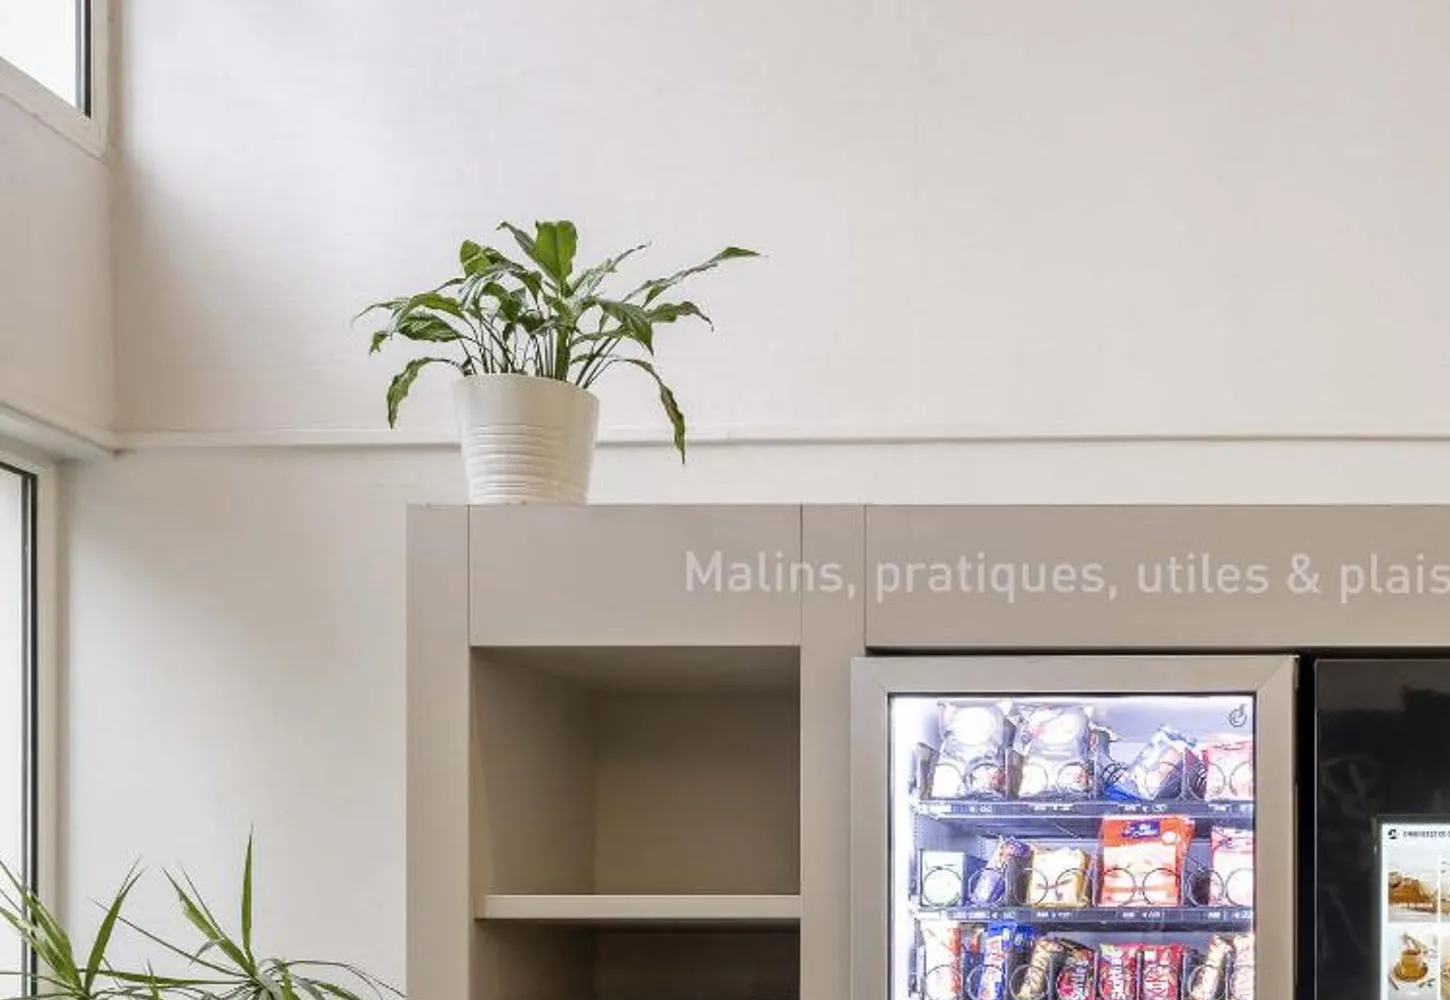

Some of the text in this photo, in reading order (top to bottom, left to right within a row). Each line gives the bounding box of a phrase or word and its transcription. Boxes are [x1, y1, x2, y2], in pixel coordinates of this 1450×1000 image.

[685, 550, 856, 600] Malins,
[876, 551, 1118, 603] pratiques,
[1136, 552, 1270, 595] utiles
[1285, 552, 1325, 595] &
